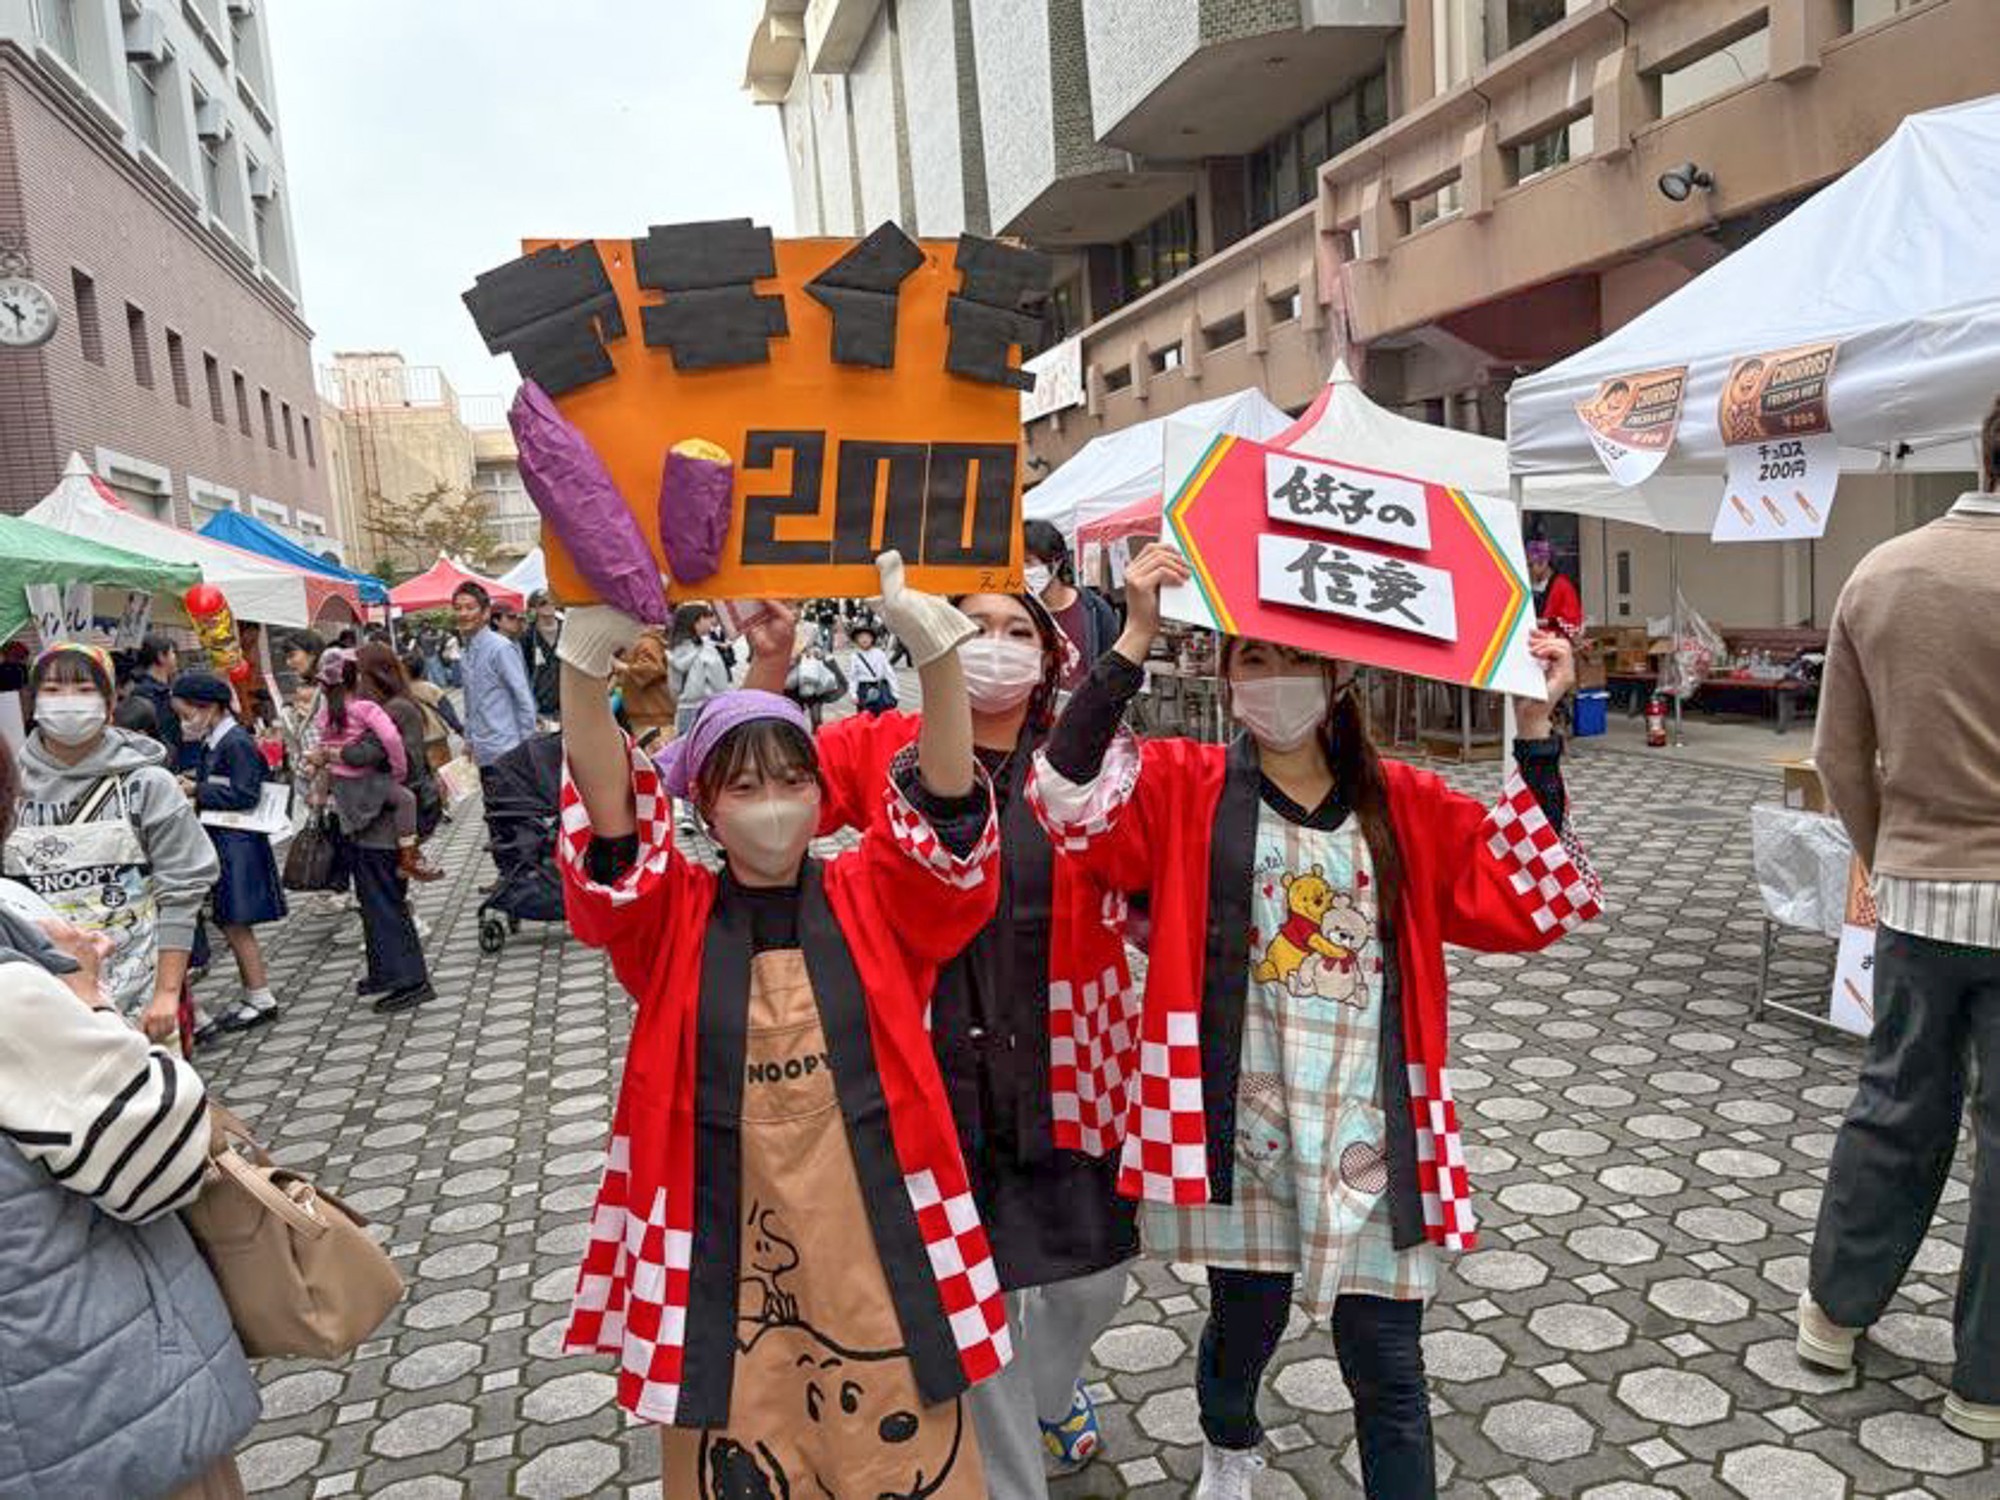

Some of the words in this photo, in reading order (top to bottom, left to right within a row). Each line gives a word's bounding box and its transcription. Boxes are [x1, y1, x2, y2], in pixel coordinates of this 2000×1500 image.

[1758, 440, 1805, 461] チュロス
[1758, 458, 1807, 481] 200円
[740, 429, 1018, 565] 200
[1273, 465, 1416, 528] 餃子の
[1285, 541, 1426, 626] 信愛
